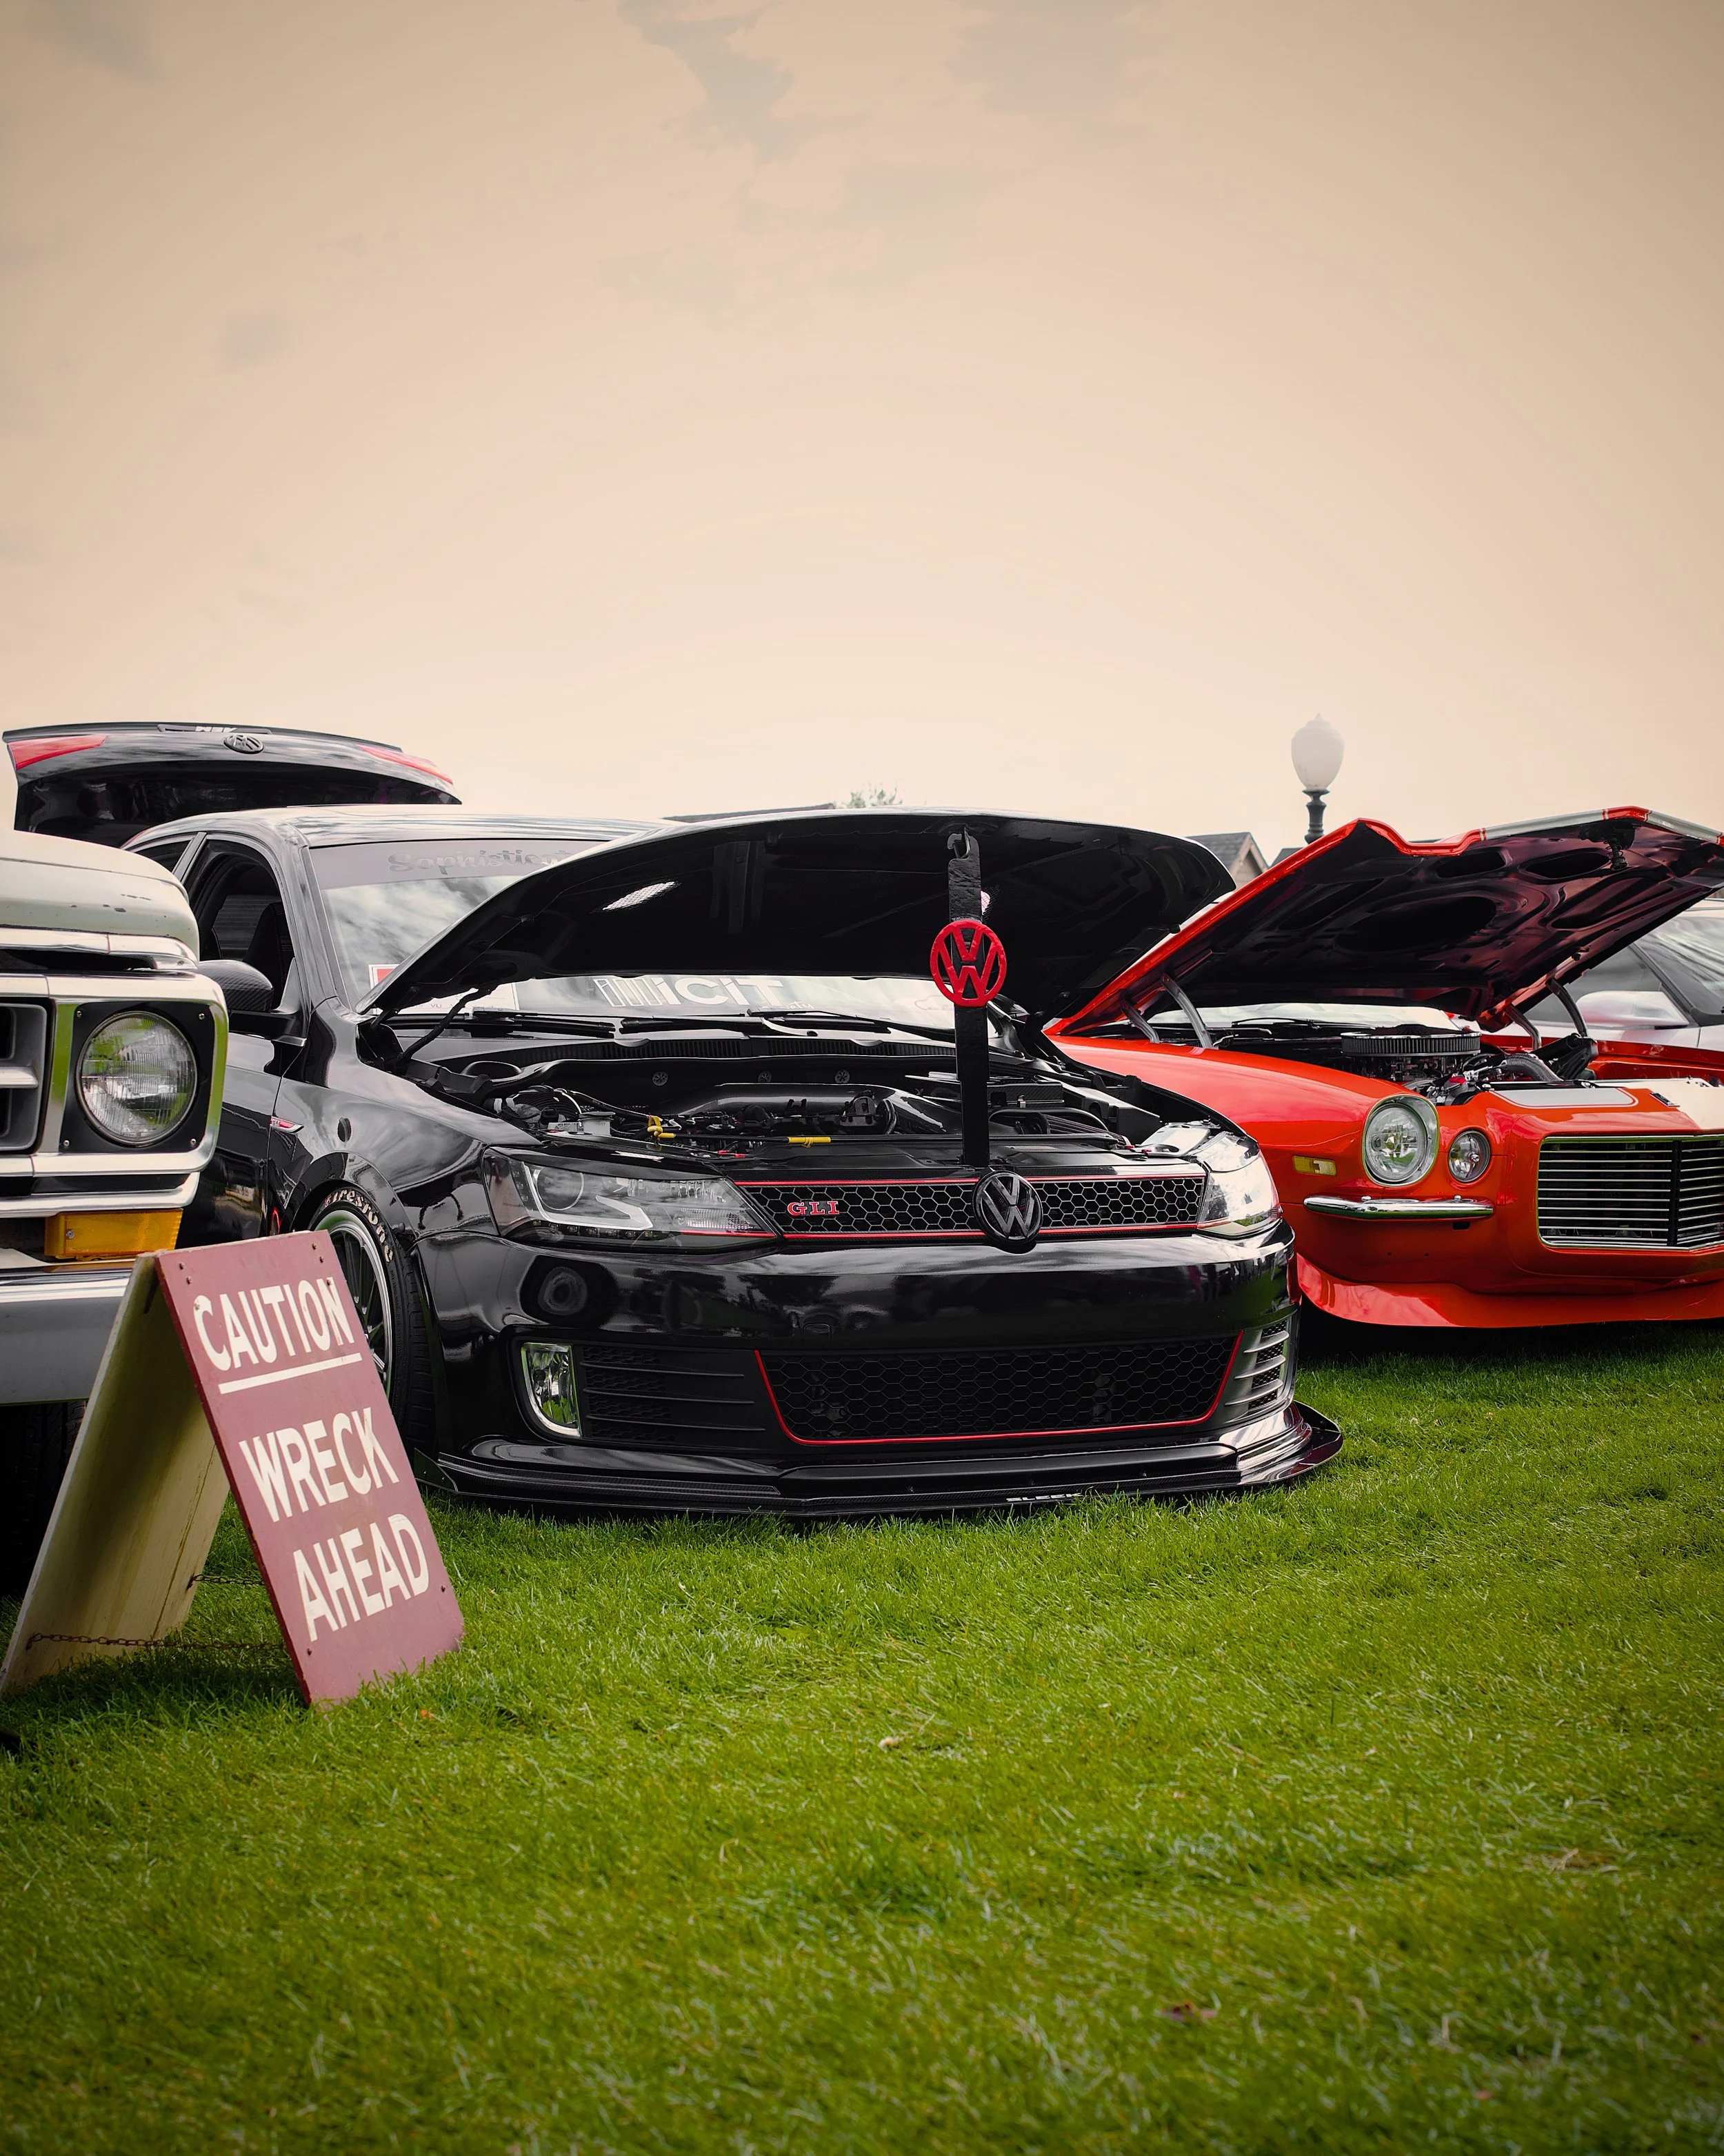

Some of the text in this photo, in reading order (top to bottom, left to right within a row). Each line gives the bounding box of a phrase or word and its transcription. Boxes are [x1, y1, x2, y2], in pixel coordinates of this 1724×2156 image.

[934, 924, 1004, 1004] VW
[324, 1188, 394, 1263] Firestone
[787, 1200, 840, 1217] GLI
[976, 1174, 1040, 1243] VW
[194, 1277, 355, 1371] CAUTION
[239, 1407, 399, 1522] WRECK
[292, 1514, 430, 1641] AHEAD
